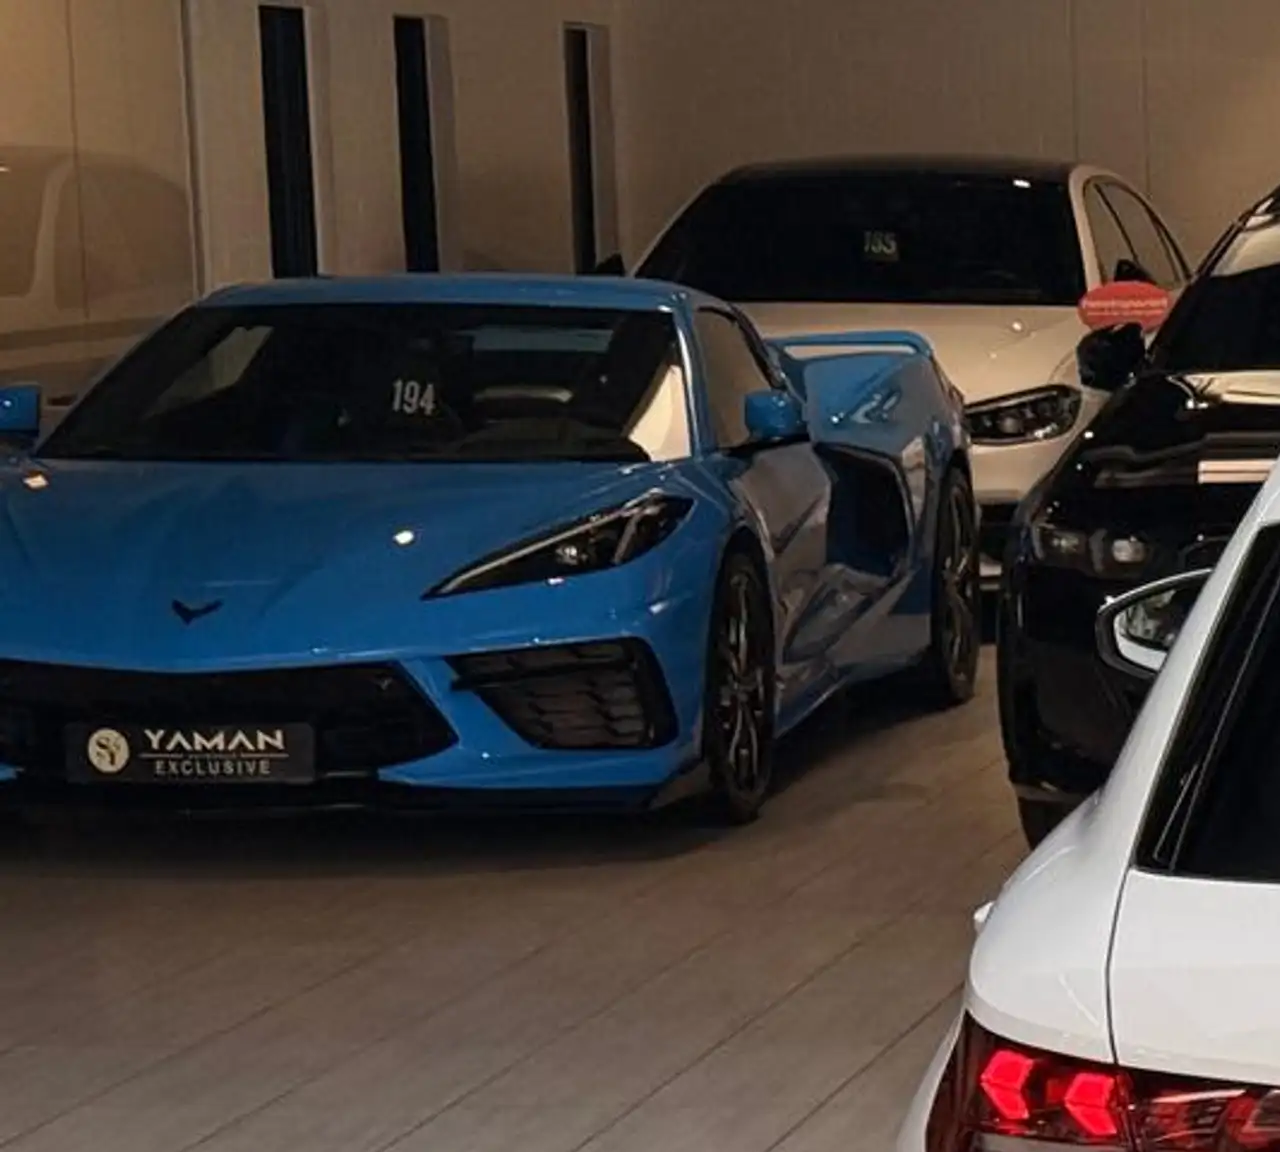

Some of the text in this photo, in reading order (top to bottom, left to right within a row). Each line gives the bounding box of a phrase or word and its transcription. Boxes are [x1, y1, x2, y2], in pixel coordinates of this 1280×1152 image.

[392, 379, 437, 416] 194
[144, 729, 285, 751] YAMAN
[155, 760, 271, 775] EXCLUSIVE
